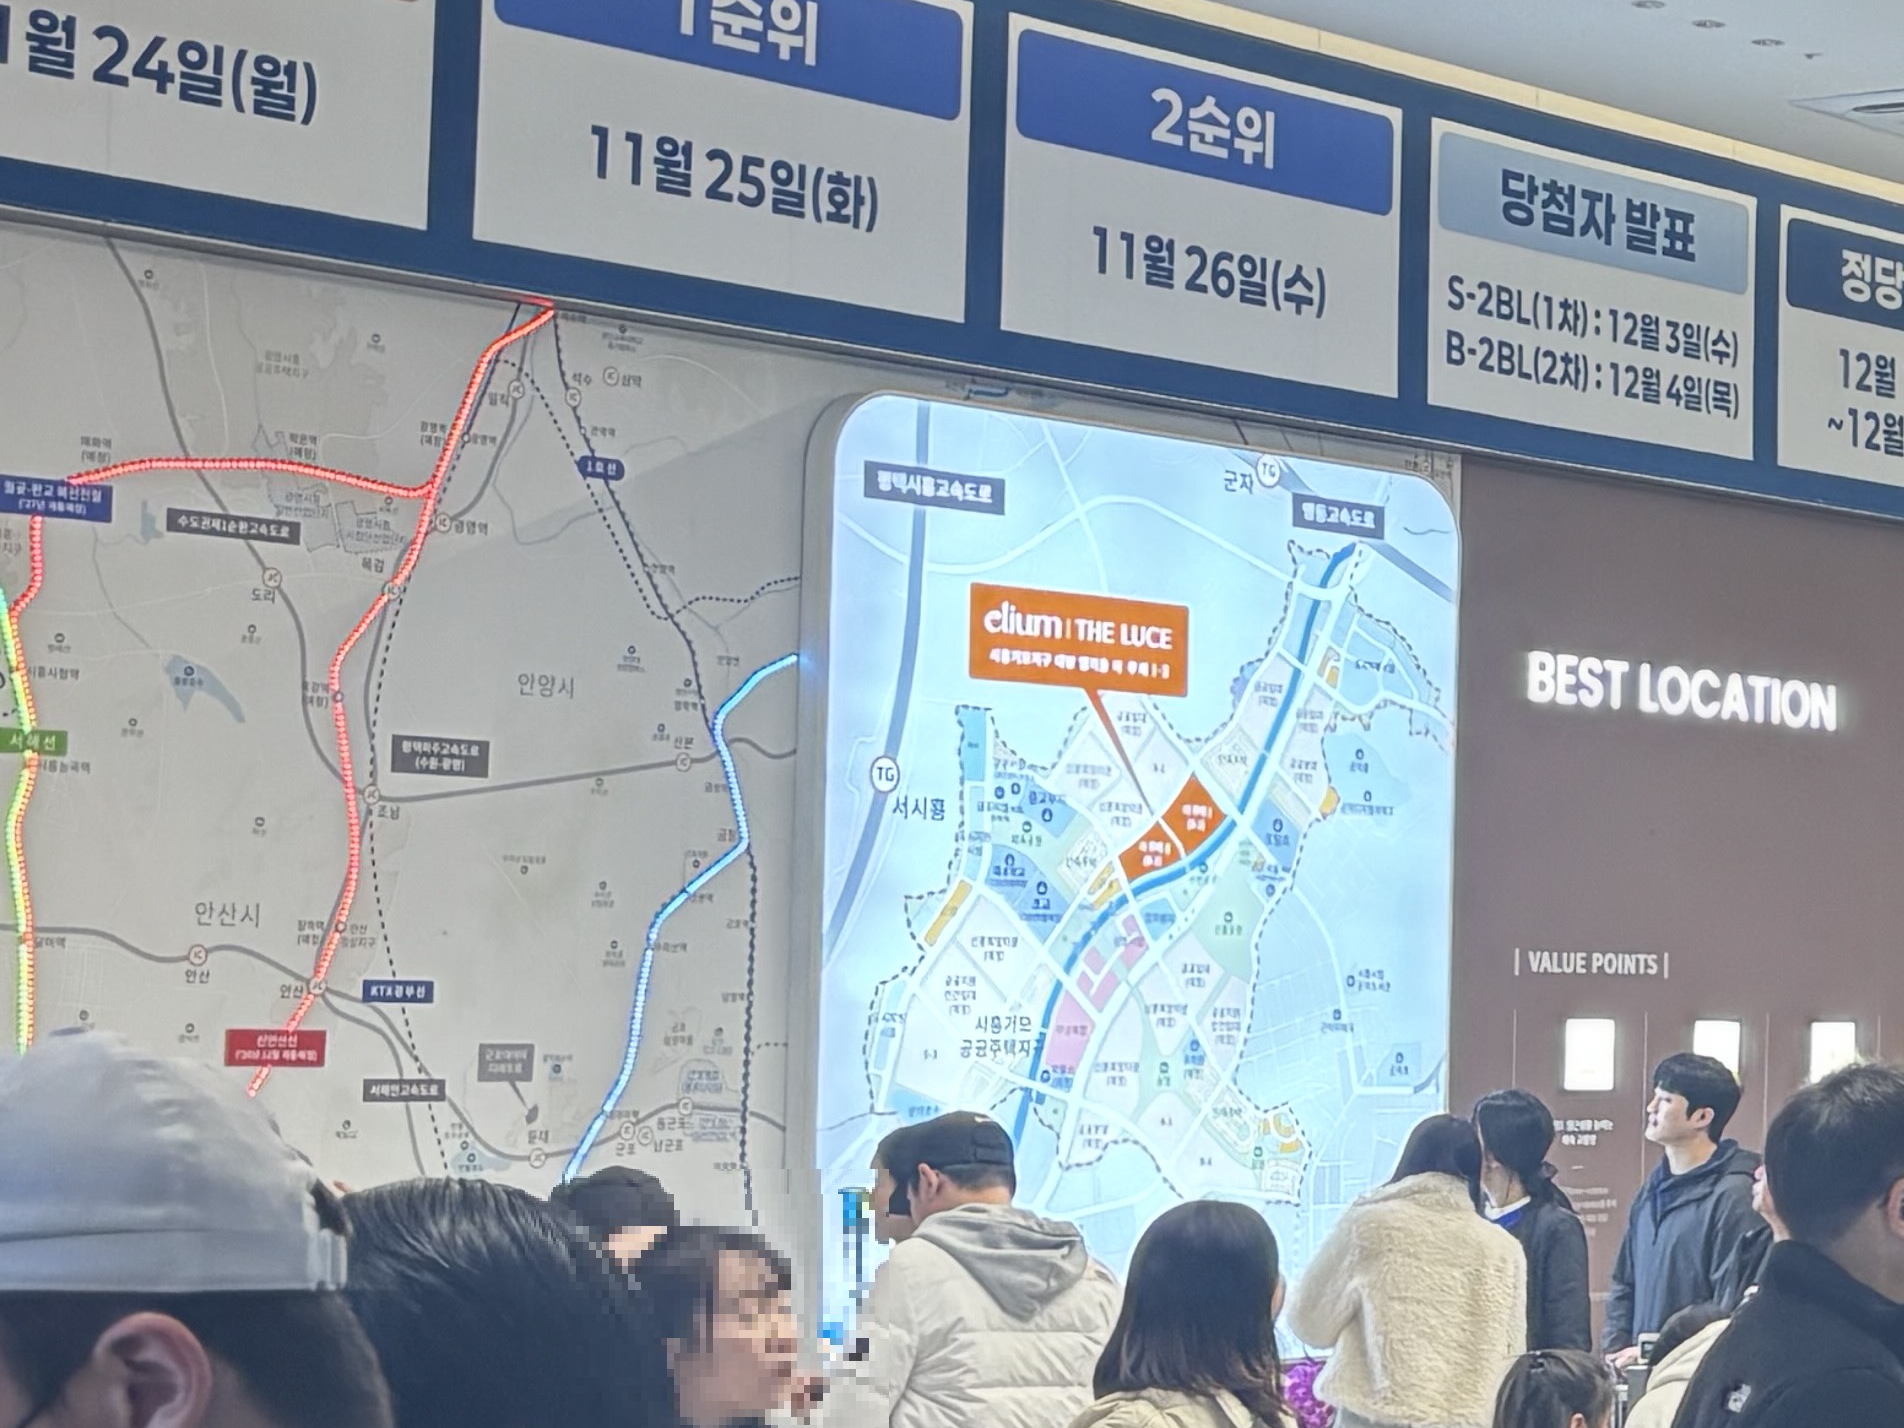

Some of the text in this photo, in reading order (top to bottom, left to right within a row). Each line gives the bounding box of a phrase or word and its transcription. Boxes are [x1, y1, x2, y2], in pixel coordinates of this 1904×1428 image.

[92, 25, 318, 126] 24일(월)
[1151, 87, 1276, 170] 2순위
[588, 122, 880, 234] 11월 25일(화)
[1501, 167, 1696, 263] 당첨자 발표
[1092, 225, 1327, 319] 11월 26일(수)
[1447, 274, 1739, 368] S-2BL(1차) 12월 3일(수)
[1445, 330, 1740, 420] B-2BL(2차) 12월 4일(목)
[1838, 347, 1896, 401] 12월
[1827, 407, 1904, 459] ~12월
[984, 600, 1173, 650] elium THE LUCE
[517, 673, 575, 699] 안양시
[1526, 650, 1838, 732] BEST LOCATION
[892, 797, 945, 824] 서시흥
[195, 901, 261, 928] 안산시
[185, 968, 210, 984] 안산
[1528, 951, 1658, 976] VALUE POINTS
